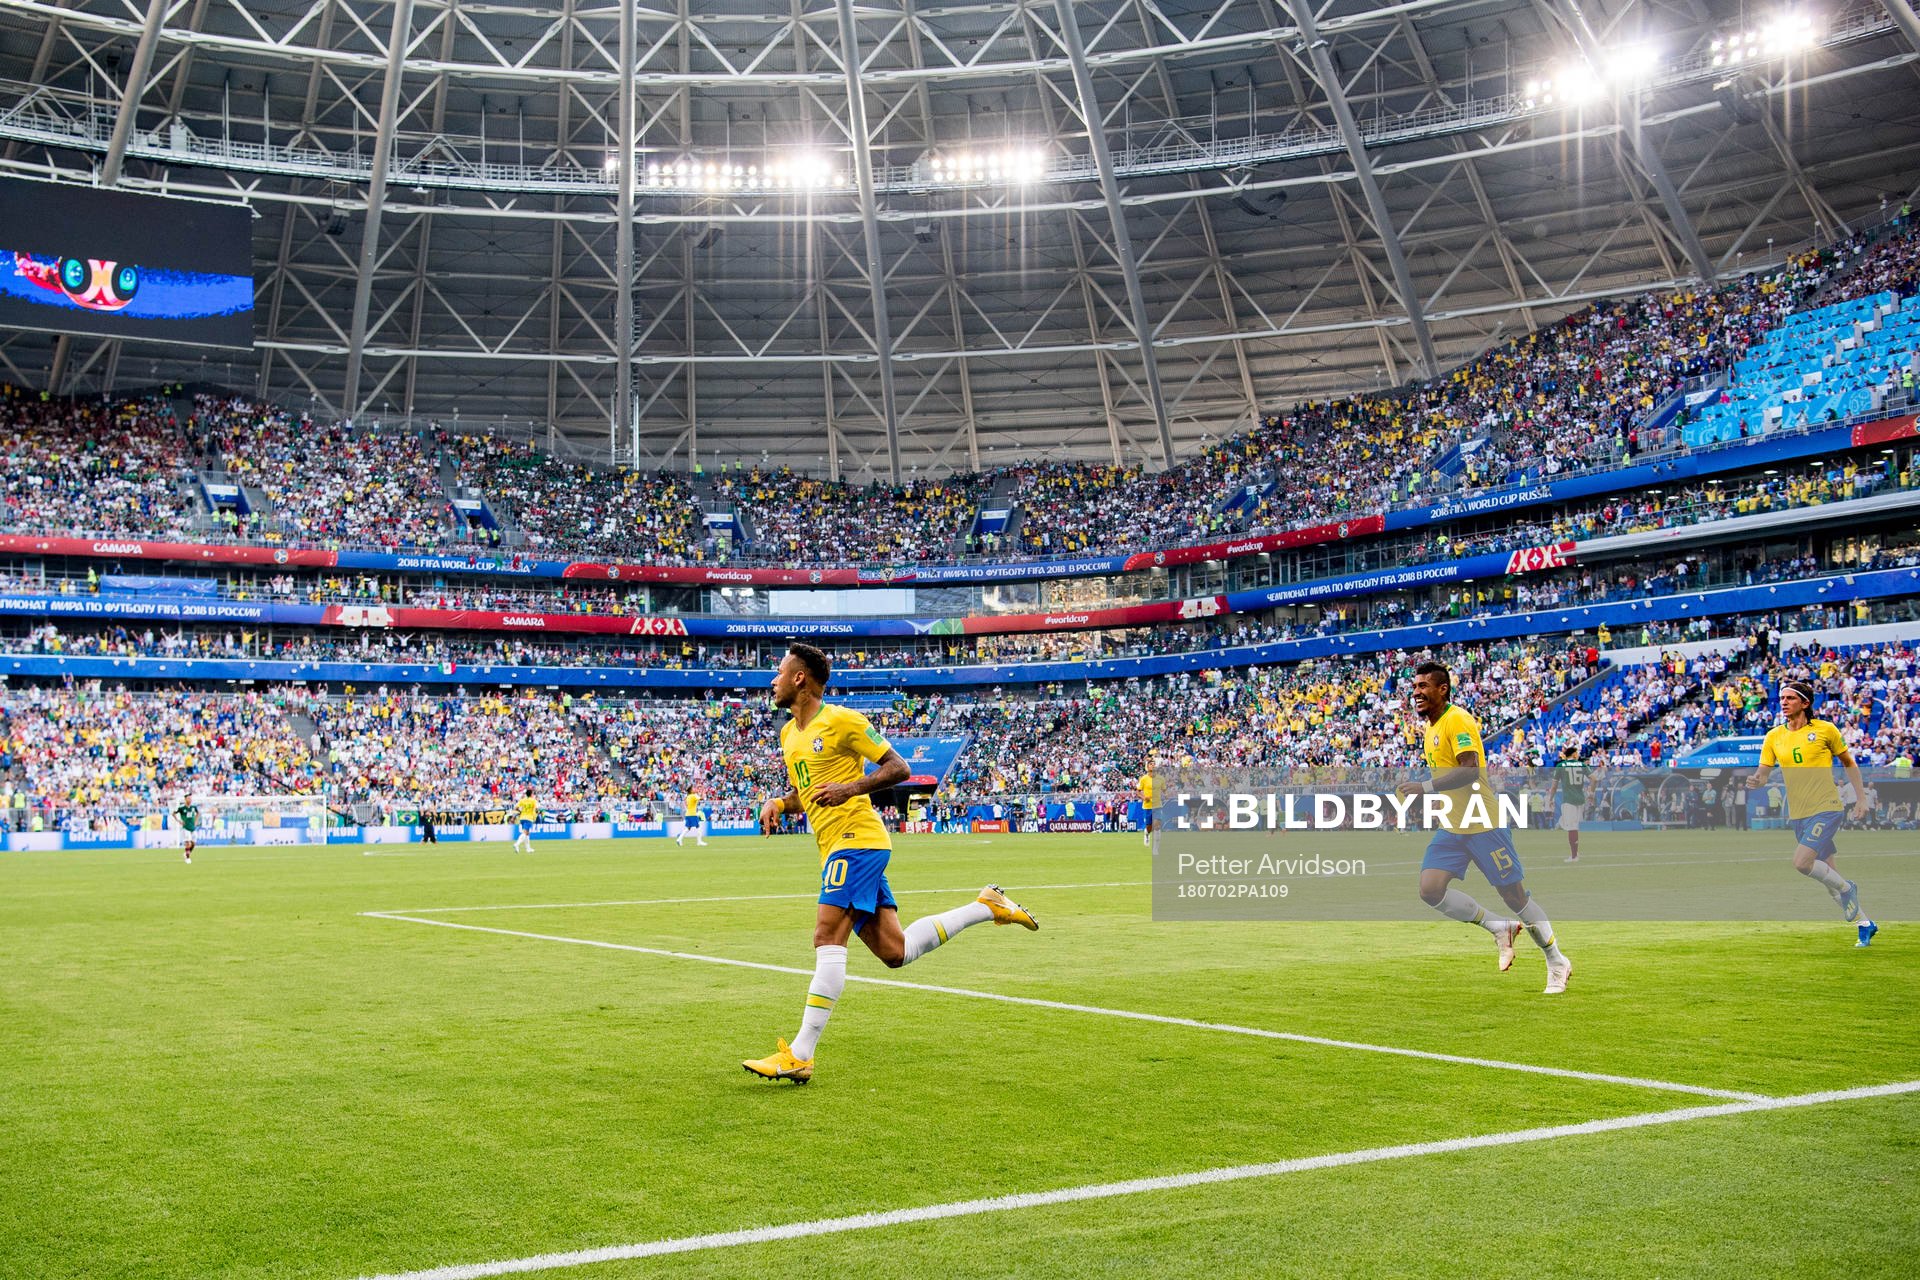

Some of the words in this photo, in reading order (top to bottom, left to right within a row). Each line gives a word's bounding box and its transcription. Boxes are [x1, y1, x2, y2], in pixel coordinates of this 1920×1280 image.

[1468, 498, 1499, 511] WORLD
[1500, 494, 1518, 506] CUP
[1227, 541, 1264, 554] #worldcup
[397, 558, 420, 568] 2018
[420, 559, 440, 569] FIFA
[476, 562, 495, 571] CUP
[1027, 566, 1046, 575] FIFA
[1047, 565, 1066, 574] 2018
[706, 570, 752, 582] #worldcup
[1380, 575, 1396, 585] FIFA
[1397, 573, 1415, 583] 2018
[157, 604, 180, 615] FIFA
[182, 605, 207, 616] 2018
[503, 616, 545, 627] SAMARA
[1045, 615, 1088, 625] #worldcup
[726, 625, 746, 633] 2018
[747, 625, 766, 633] FIFA
[767, 625, 798, 633] WORLD
[799, 625, 818, 633] CUP
[820, 625, 853, 633] RUSSIA
[1707, 757, 1739, 765] SAMARA
[1792, 747, 1803, 764] 6
[794, 759, 811, 790] 10
[1565, 767, 1584, 785] 16
[1021, 821, 1039, 833] VISA
[1049, 822, 1068, 832] QATAR
[1068, 822, 1092, 831] AIRWAYS
[1811, 822, 1826, 837] 6
[1490, 847, 1513, 871] 15
[824, 859, 849, 886] 10
